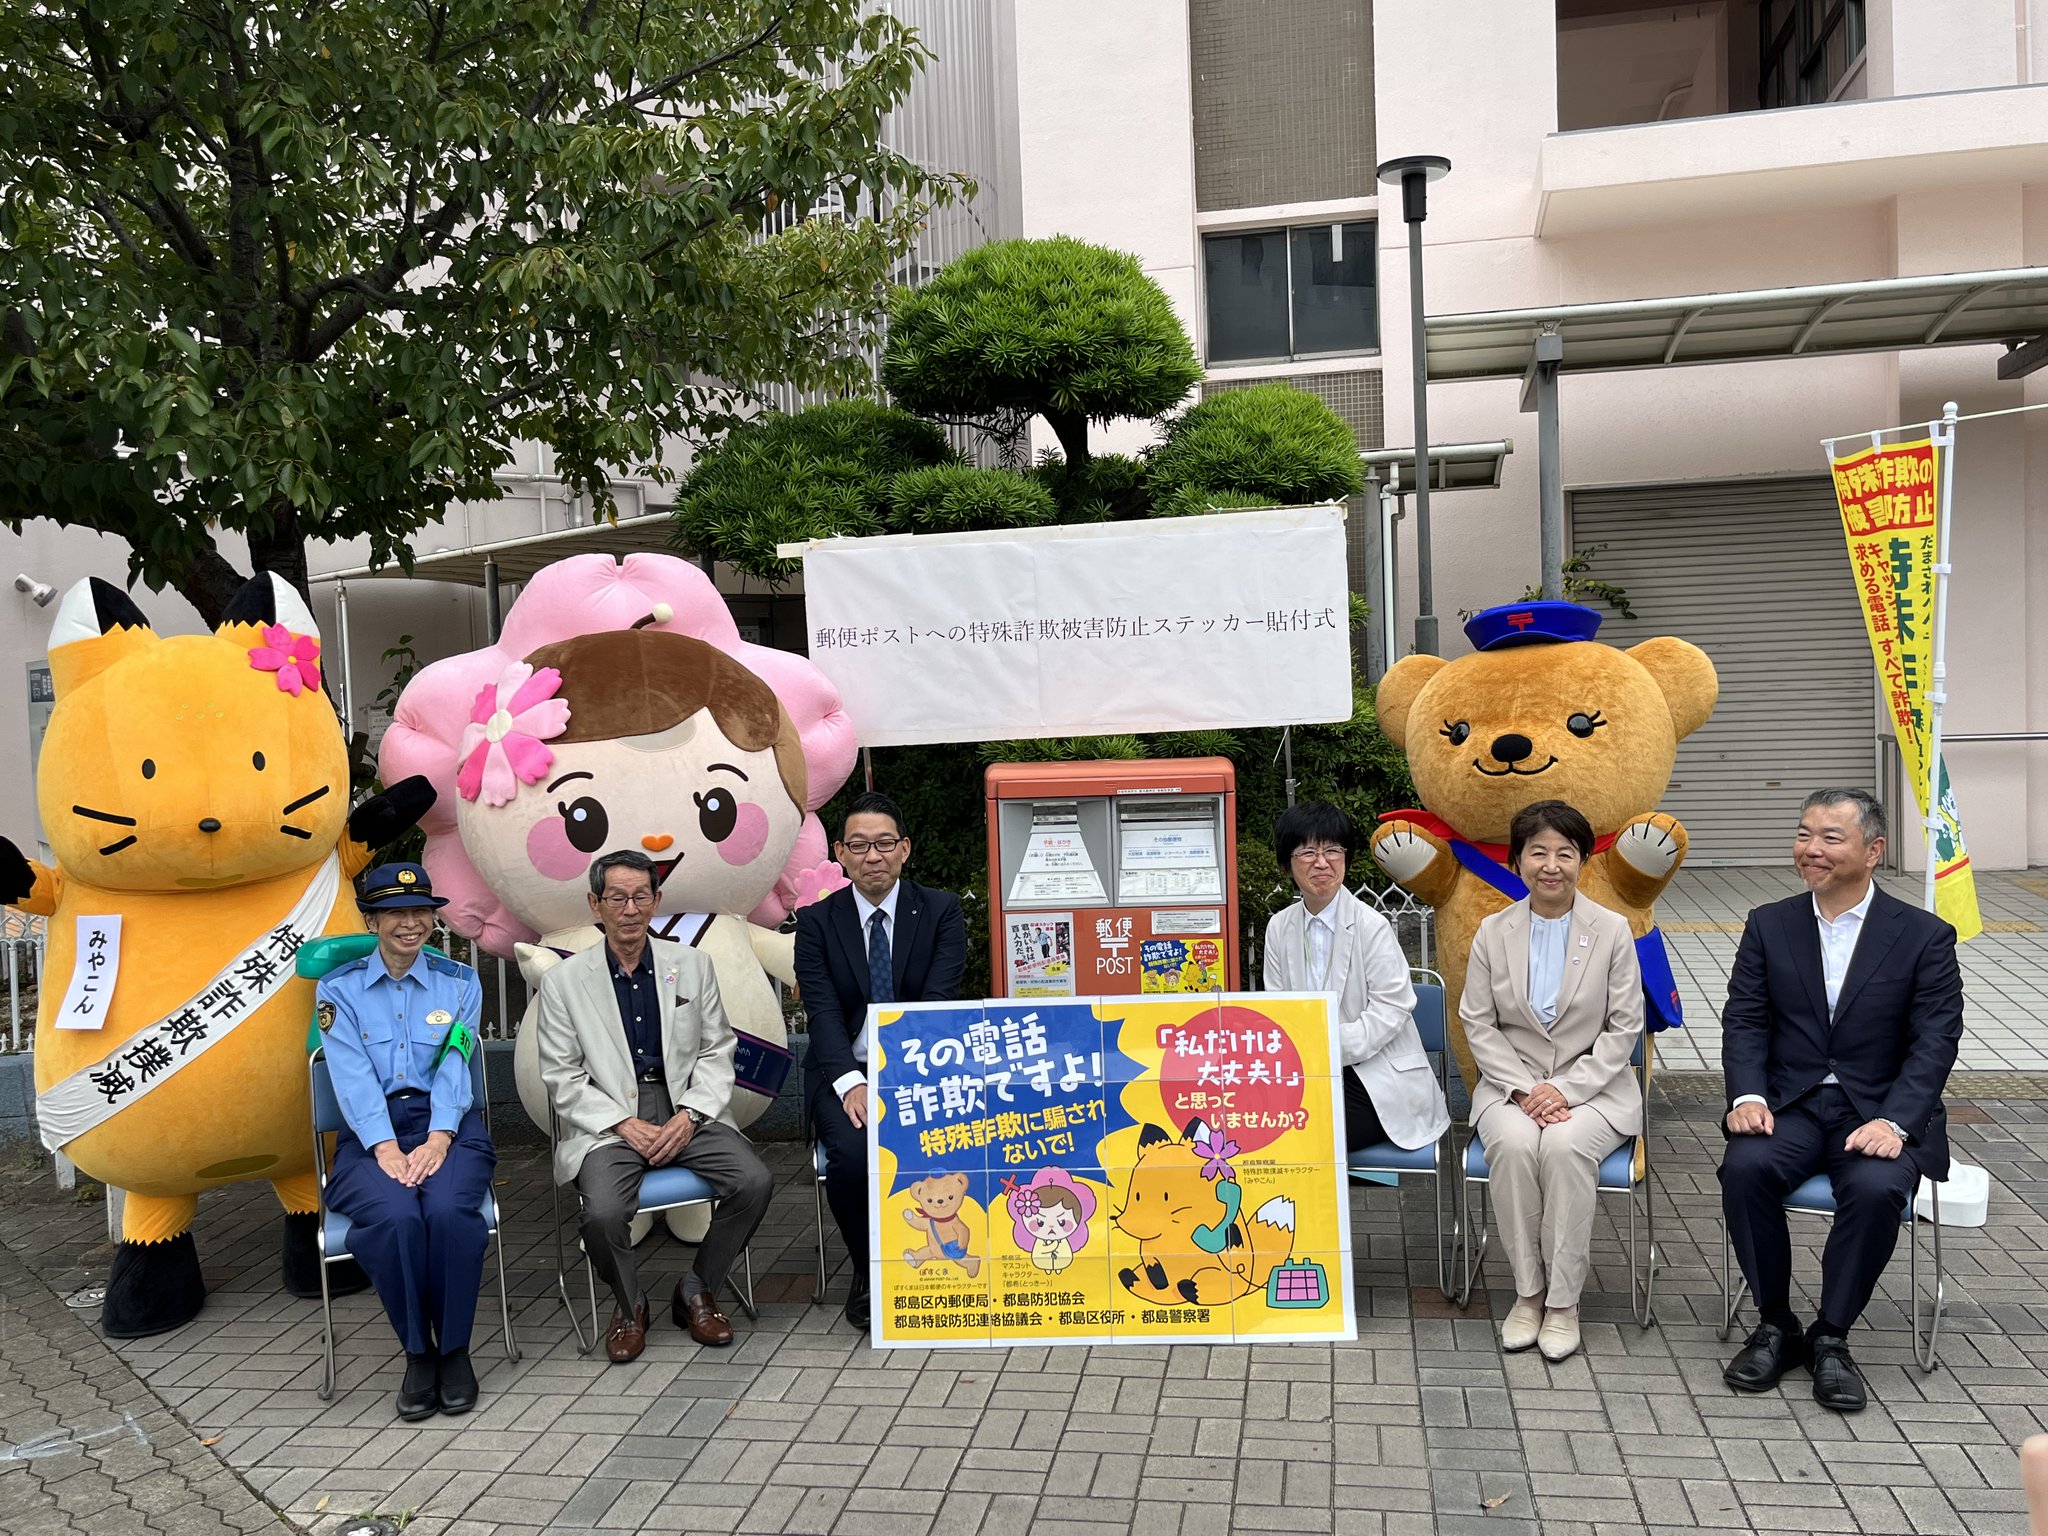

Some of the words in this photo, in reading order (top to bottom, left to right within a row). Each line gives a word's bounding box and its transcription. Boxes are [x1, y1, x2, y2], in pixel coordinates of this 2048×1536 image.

[816, 607, 1337, 650] 郵便ポストへの特殊詐欺被害防止ステッカー貼付式
[1095, 917, 1133, 939] 郵便
[73, 929, 107, 1015] みやこん
[1096, 957, 1134, 975] POST
[89, 922, 304, 1105] 特殊詐欺撲滅
[901, 1012, 1047, 1070] その電話
[1160, 1027, 1283, 1057] 「私だけは
[1196, 1060, 1300, 1087] 大丈夫!」
[894, 1055, 1103, 1127] 詐欺ですよ!
[1174, 1091, 1236, 1110] と思って
[919, 1099, 1107, 1158] 特殊詐欺に騙され
[1210, 1111, 1308, 1131] いませんか?
[1003, 1132, 1075, 1165] ないで!
[1002, 1262, 1031, 1270] マスコット
[1002, 1271, 1040, 1279] キャラクター
[893, 1291, 1086, 1311] 都島区内郵便局・都島防犯協会
[893, 1308, 1211, 1330] 都島特設防犯連絡協議会・都島区役所・都島警察署
